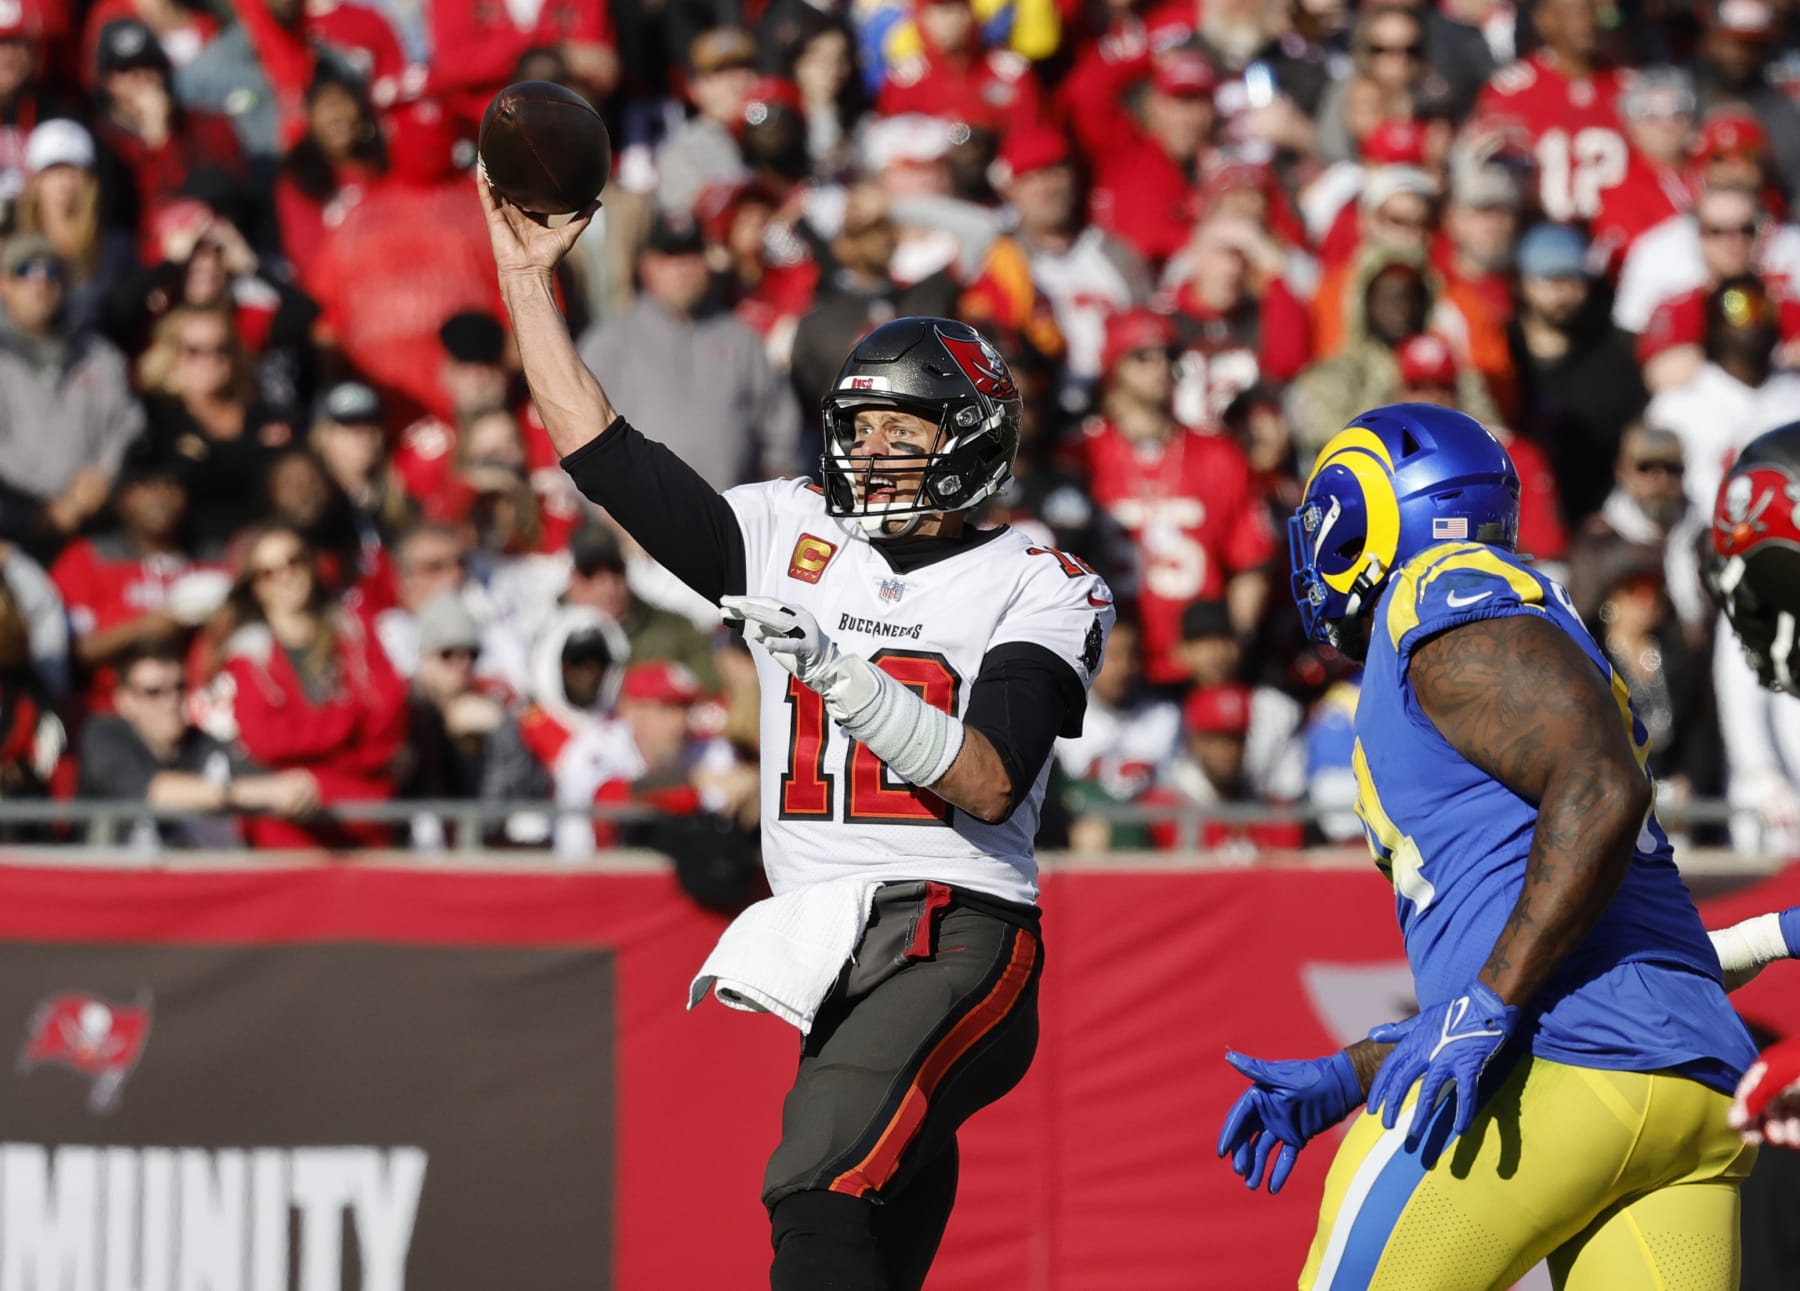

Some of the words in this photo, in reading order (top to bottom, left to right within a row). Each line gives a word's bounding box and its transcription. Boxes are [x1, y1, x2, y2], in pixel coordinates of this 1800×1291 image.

[1536, 125, 1630, 222] 12
[794, 537, 831, 572] C
[778, 647, 962, 828] 12
